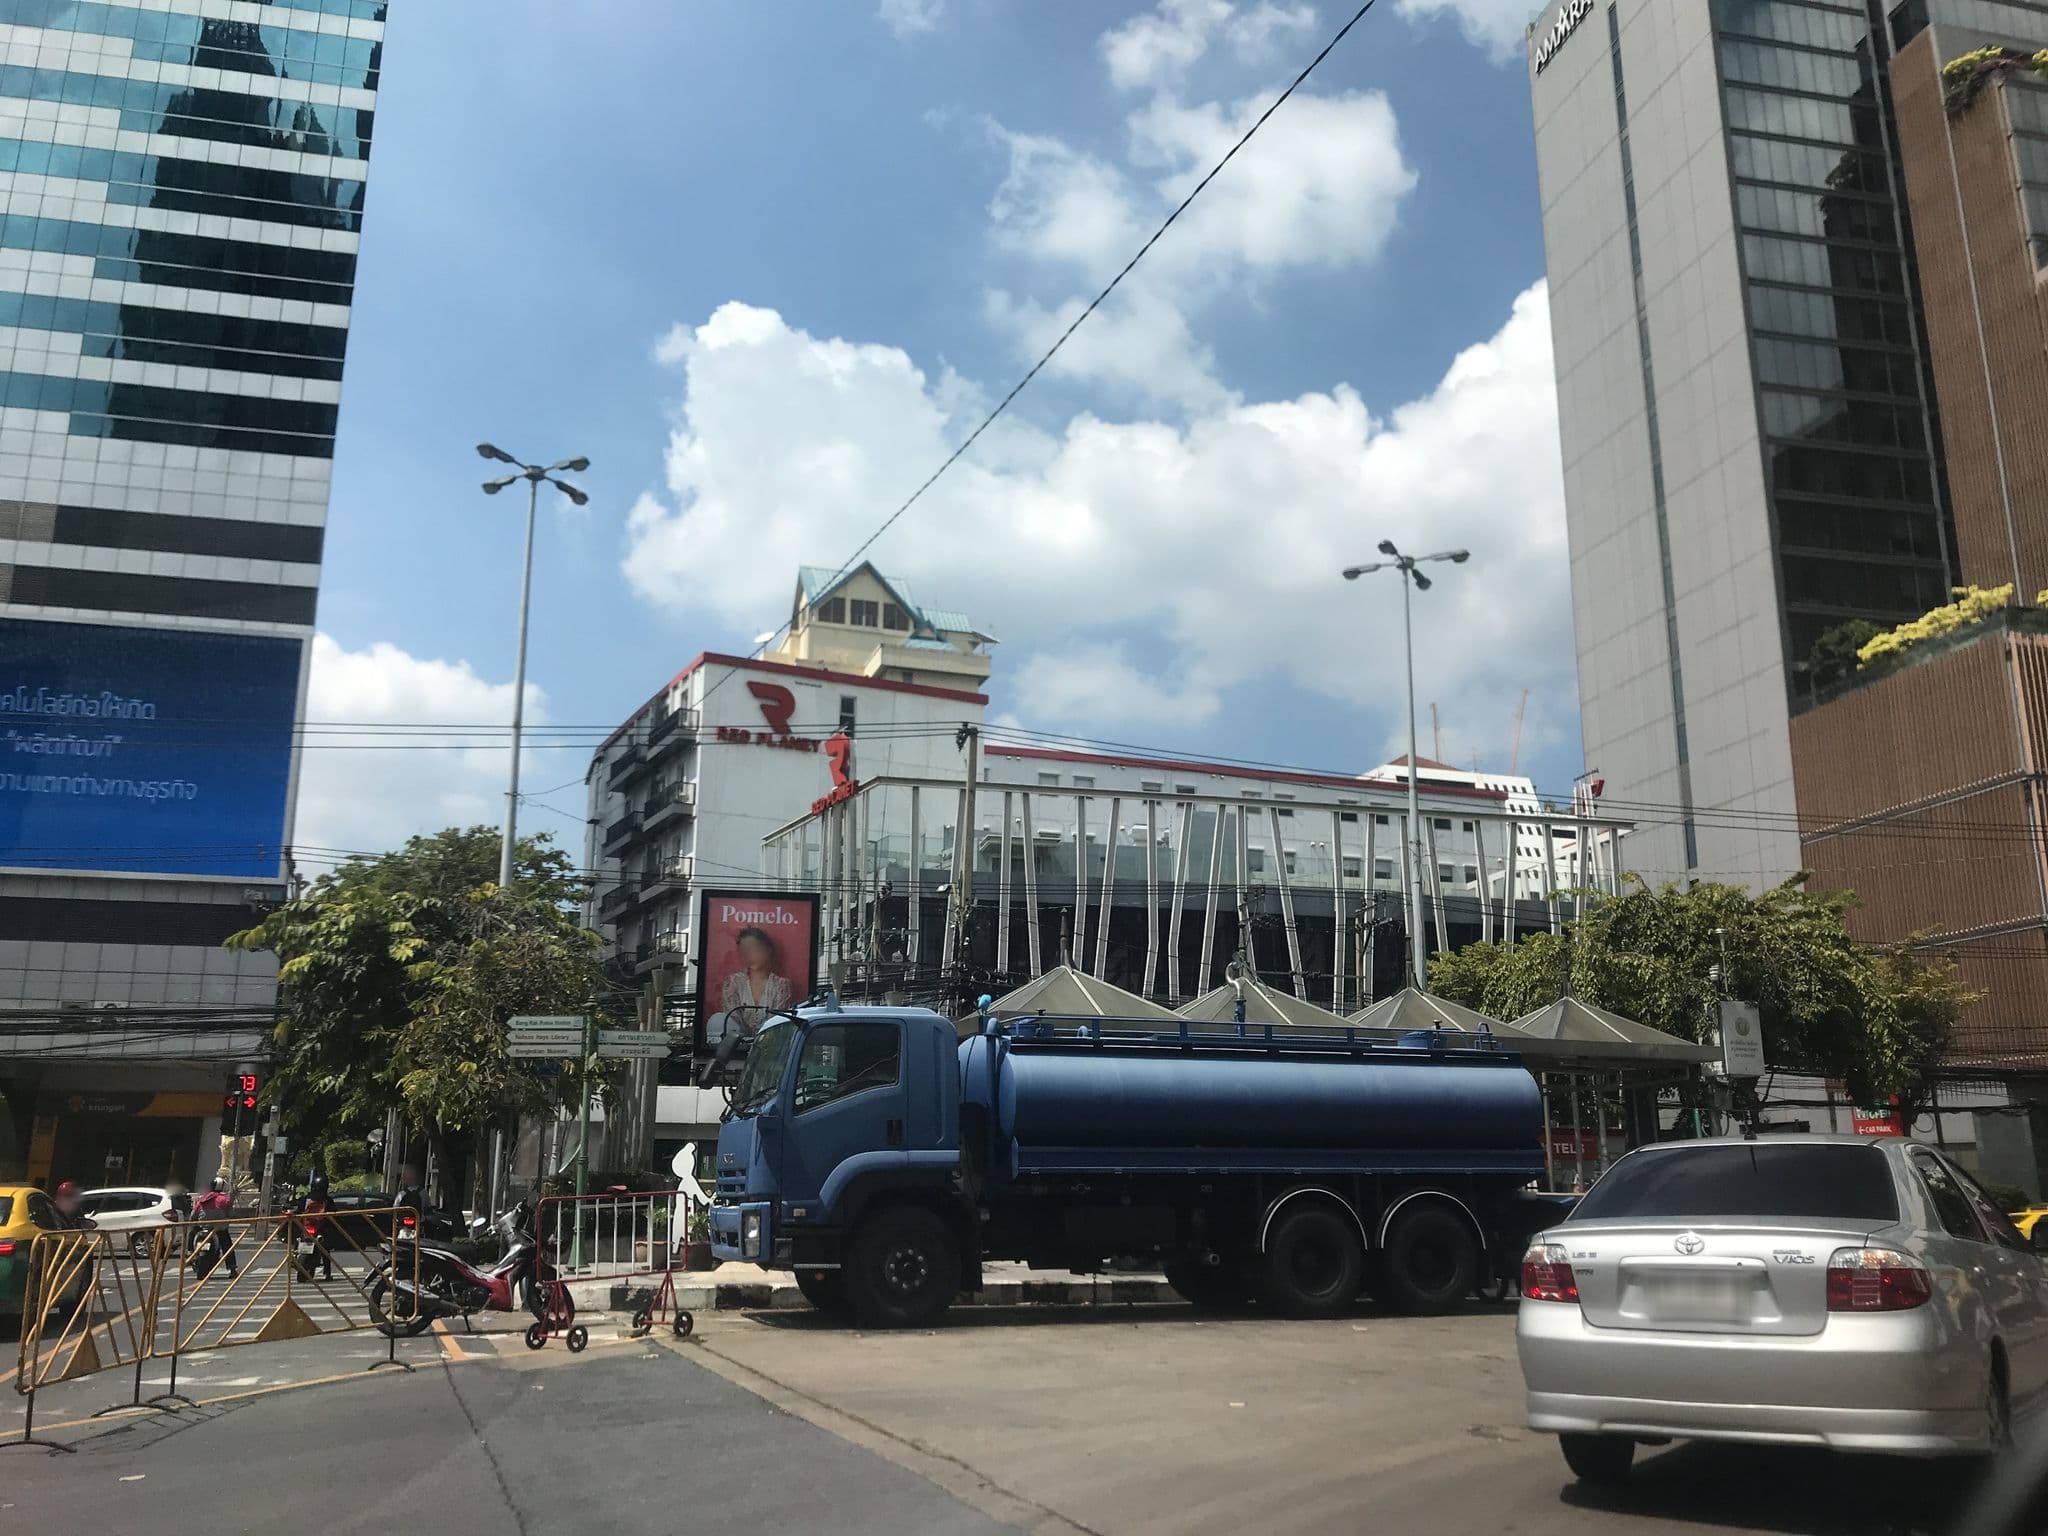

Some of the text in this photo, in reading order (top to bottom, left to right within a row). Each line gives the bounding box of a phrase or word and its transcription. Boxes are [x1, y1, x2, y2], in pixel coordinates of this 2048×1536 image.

[721, 905, 799, 925] Pomelo.
[239, 1076, 256, 1091] 73
[1865, 1125, 1876, 1134] CAR
